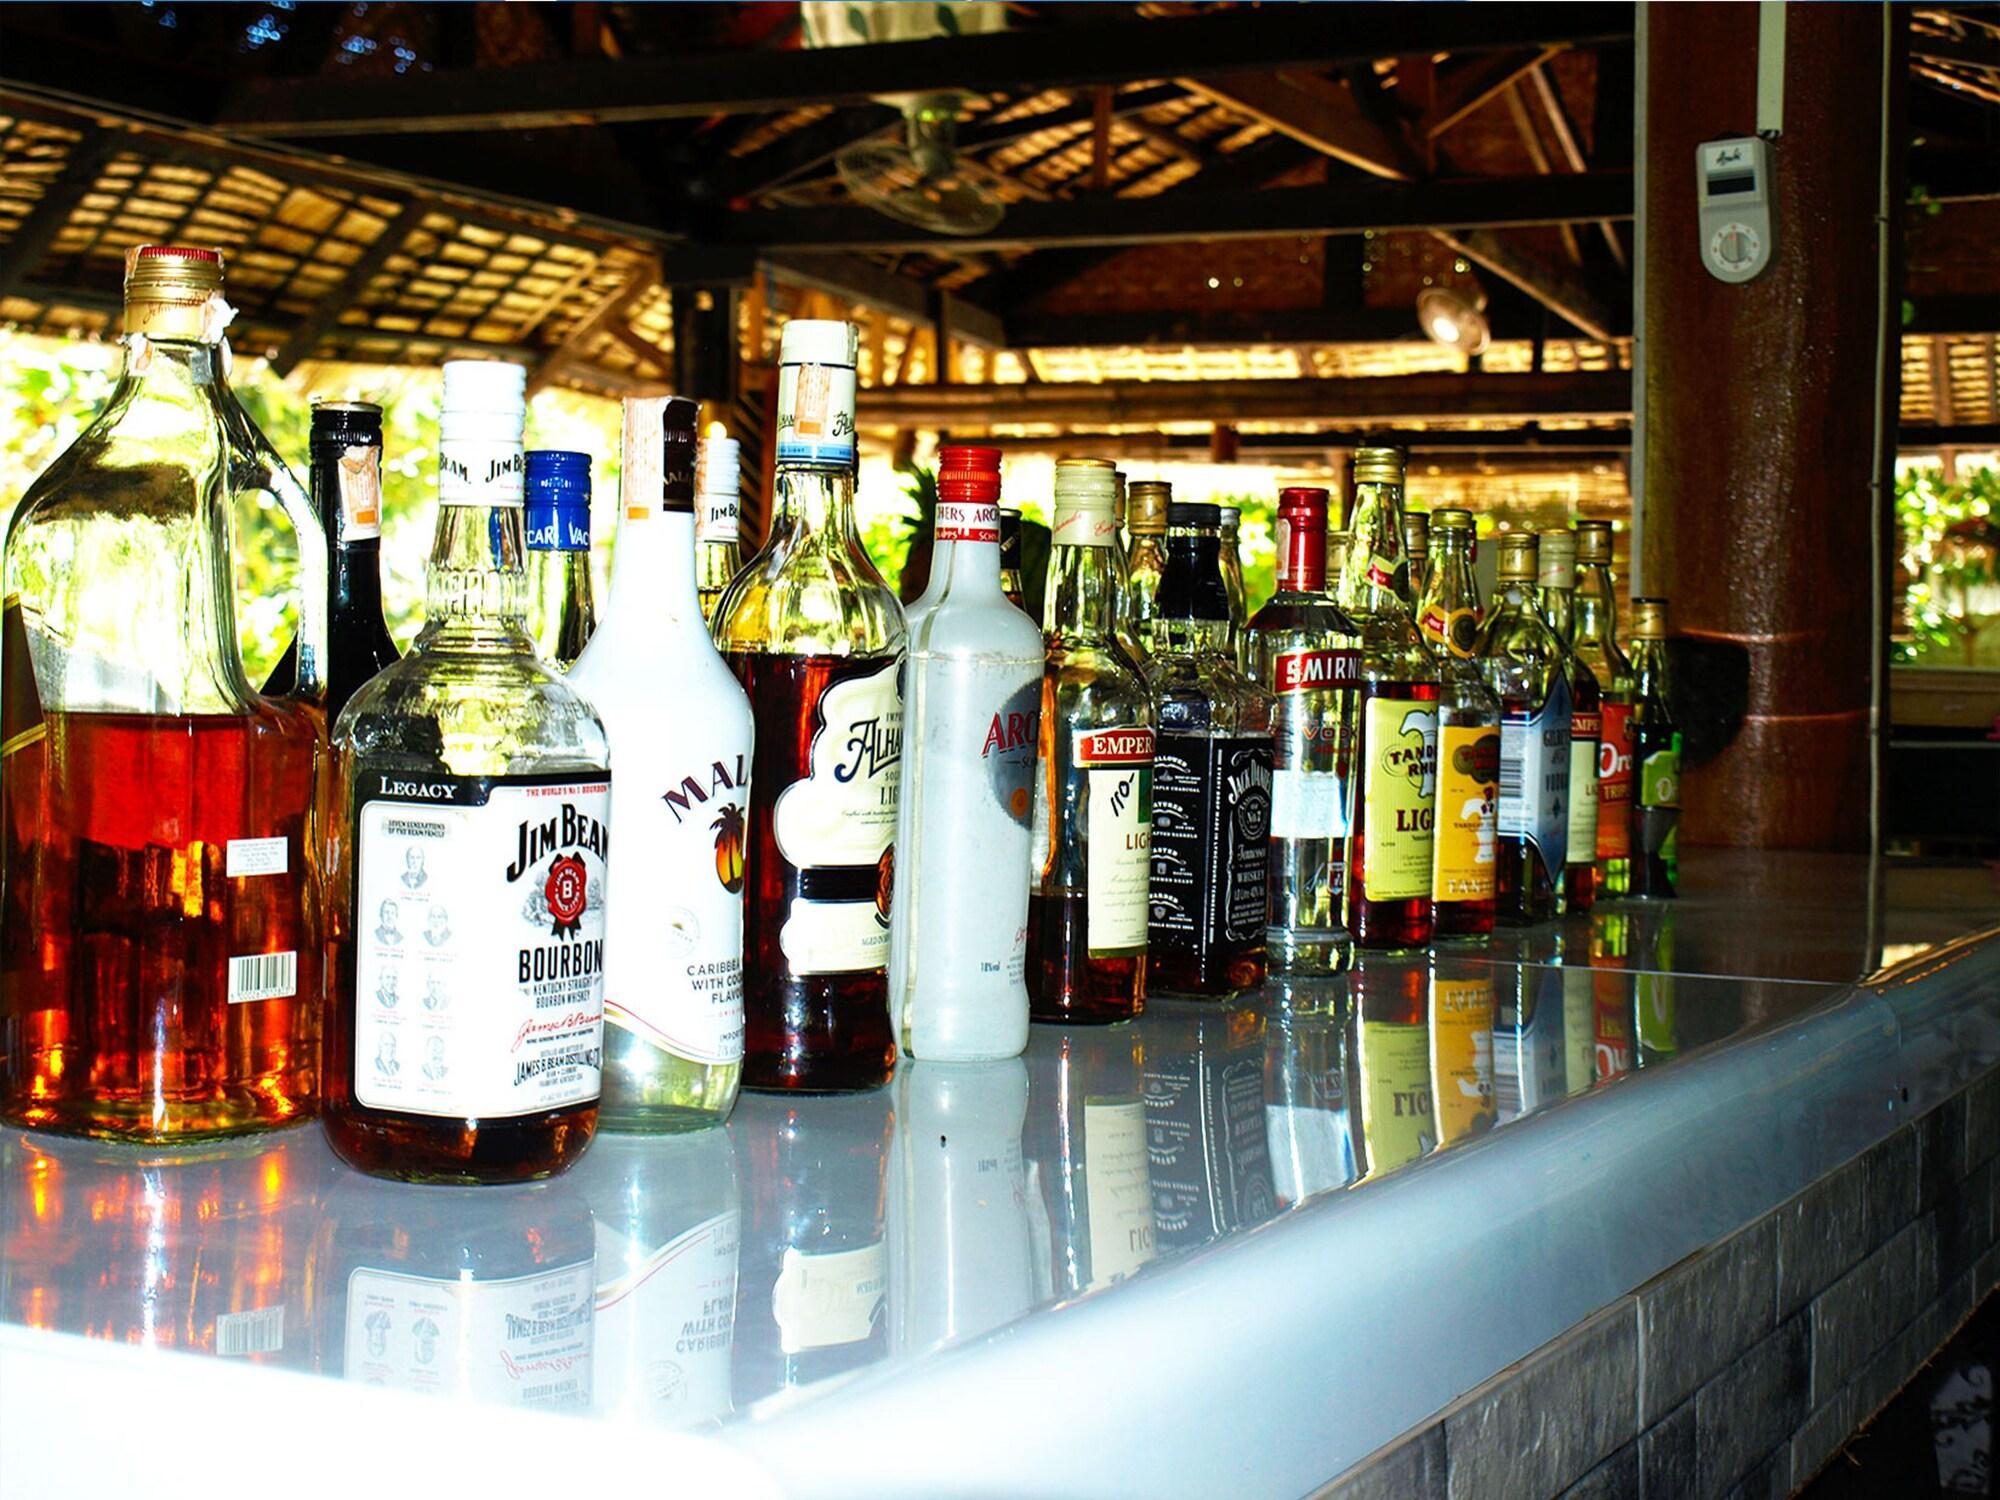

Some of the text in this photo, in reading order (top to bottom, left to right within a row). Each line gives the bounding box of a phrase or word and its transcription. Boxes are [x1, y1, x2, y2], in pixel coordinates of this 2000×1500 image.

[1154, 755, 1187, 768] ELLOWED
[380, 776, 457, 799] LEGACY
[1153, 801, 1183, 812] ATURED
[507, 817, 557, 883] JIM
[1153, 847, 1178, 857] ASTED
[562, 880, 573, 899] B
[519, 939, 603, 983] BOURBON
[534, 975, 593, 996] KENTUCKY STRAIGHT
[692, 978, 724, 991] WITH
[536, 990, 591, 1009] BOURBON WHISKEY
[513, 1059, 541, 1087] JAMES
